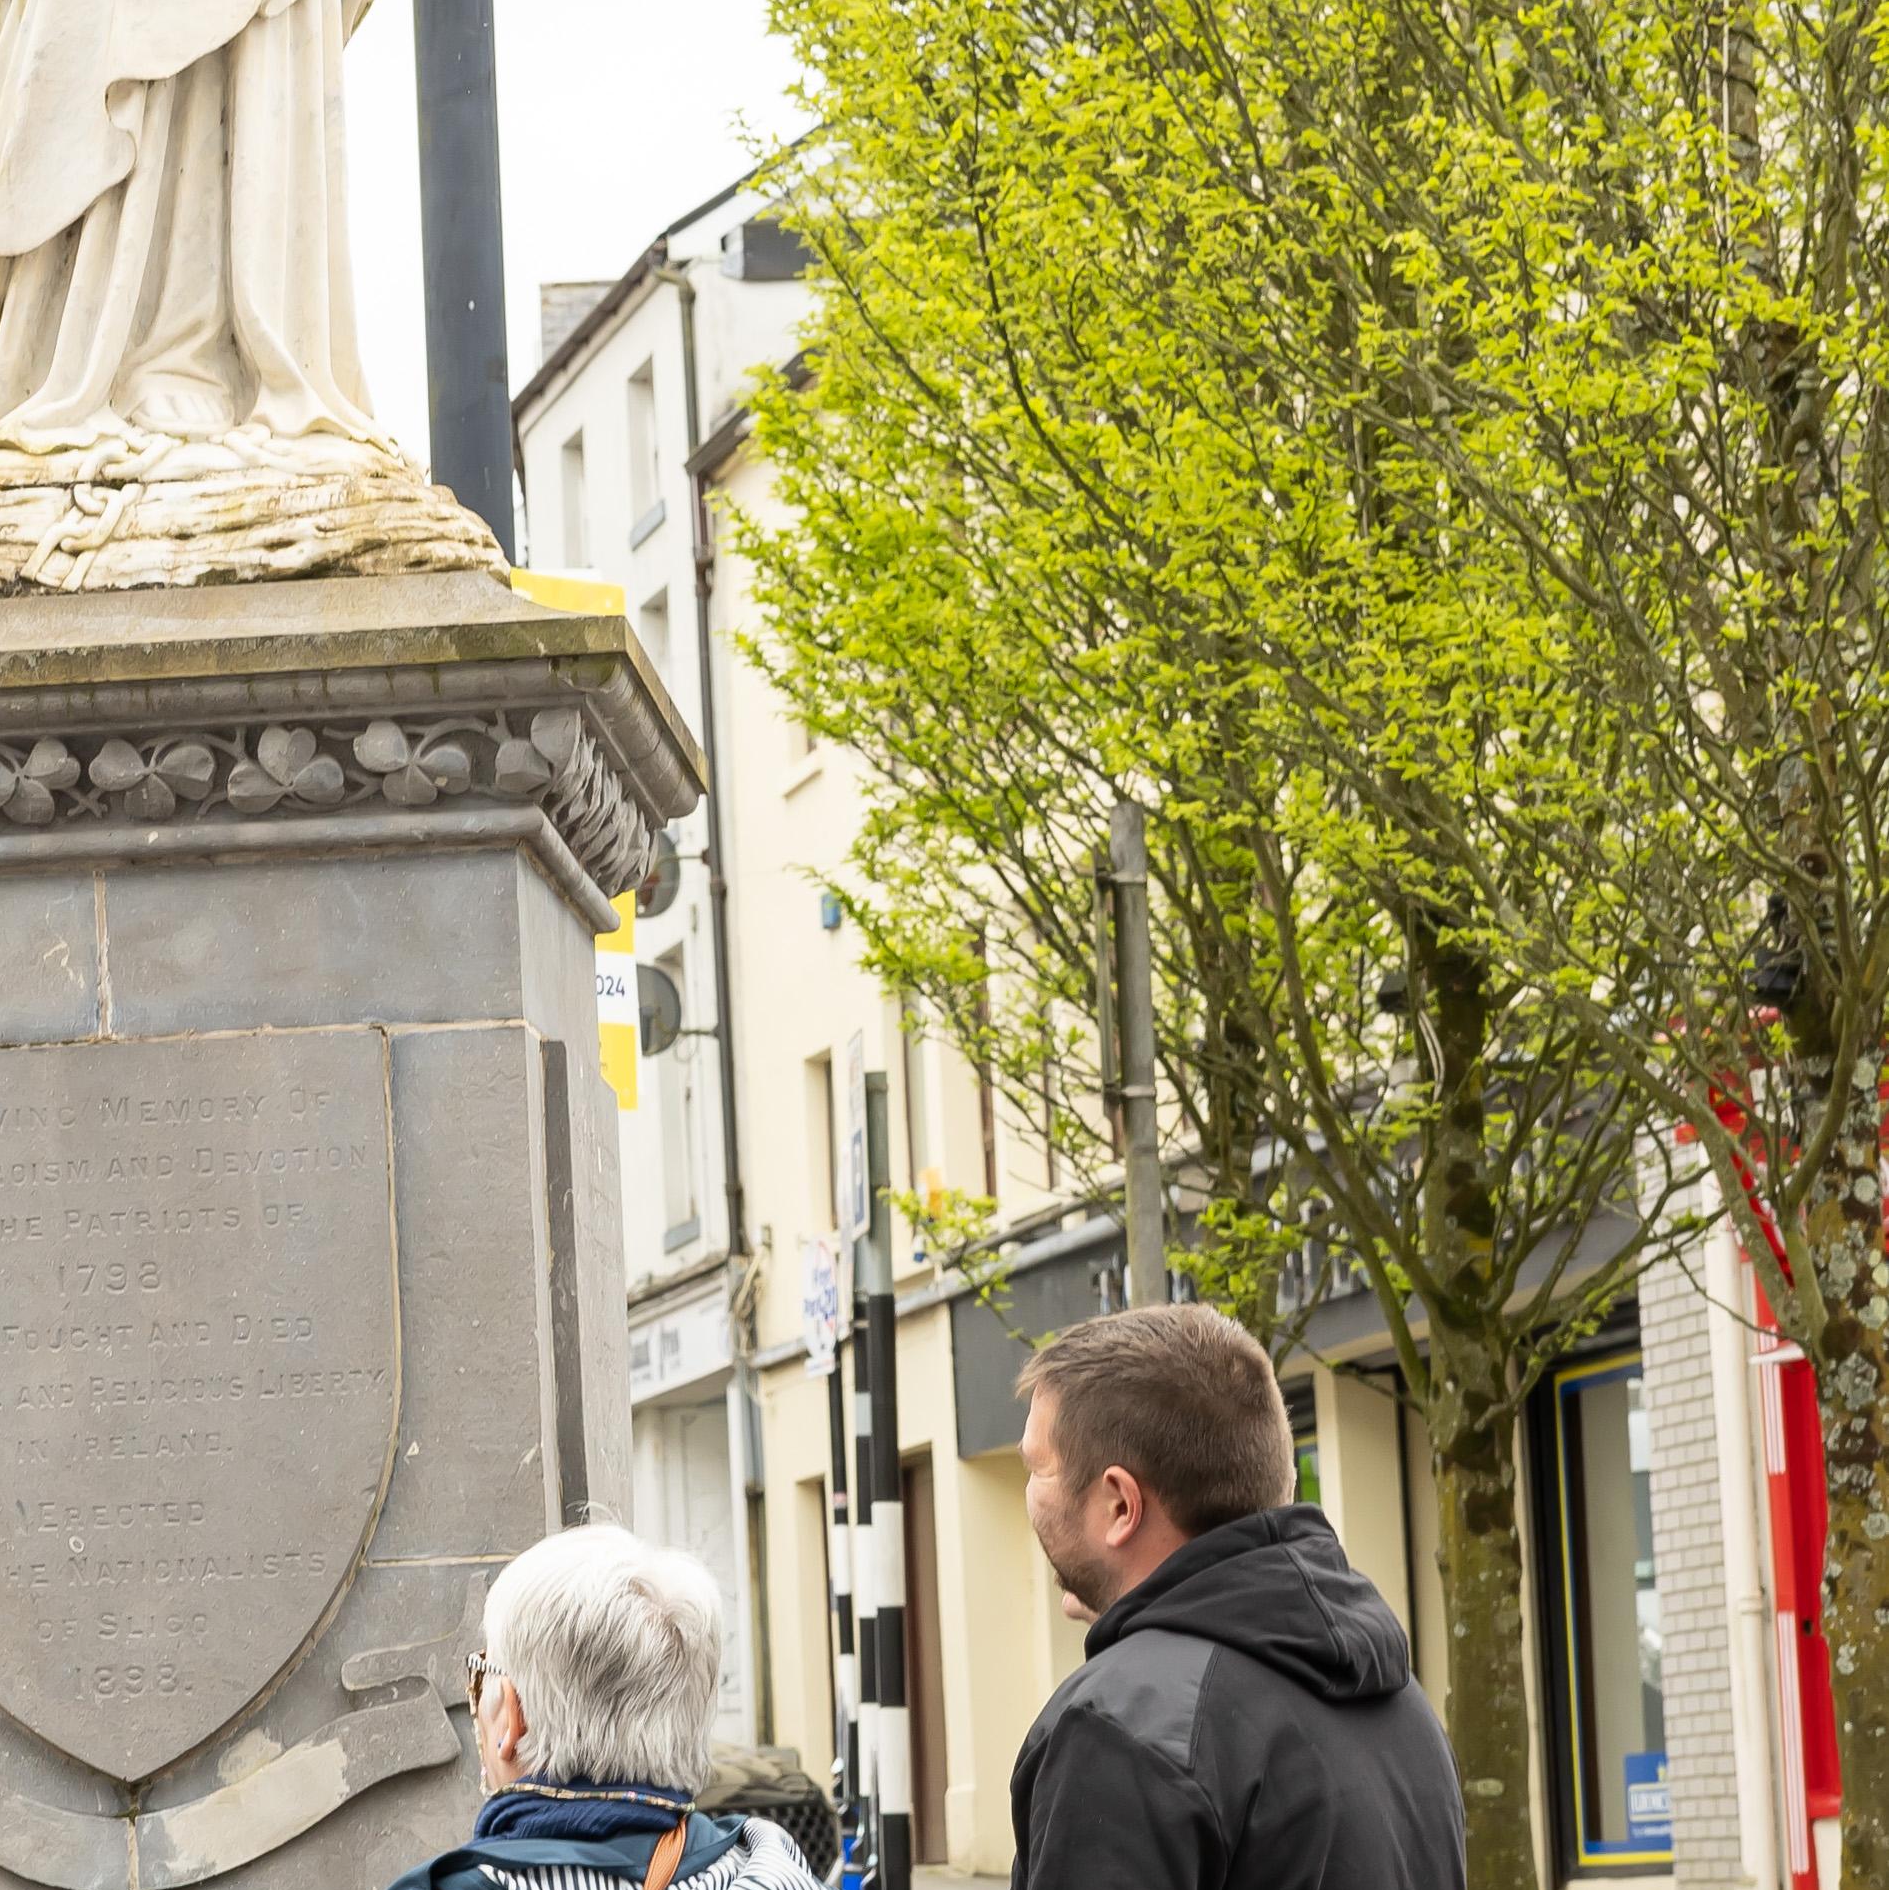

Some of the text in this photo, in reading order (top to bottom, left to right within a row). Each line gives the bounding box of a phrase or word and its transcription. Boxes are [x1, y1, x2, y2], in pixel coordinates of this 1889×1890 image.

[101, 1094, 269, 1127] MEMORY
[288, 1086, 331, 1117] OF
[106, 1153, 177, 1184] AND
[195, 1144, 369, 1181] DEVOTION
[63, 1206, 243, 1238] PATRIOTS
[261, 1202, 307, 1229] OF
[57, 1260, 165, 1298] 1798
[1, 1322, 135, 1357] FOUGHT
[145, 1318, 213, 1350] AND
[230, 1312, 315, 1346] DIED
[14, 1382, 77, 1413] AND
[87, 1374, 246, 1409] RELIGIOUS
[36, 1499, 207, 1535] ERECTED
[64, 1550, 329, 1589] NATIONALISTS
[35, 1611, 211, 1645] OF SLIGO
